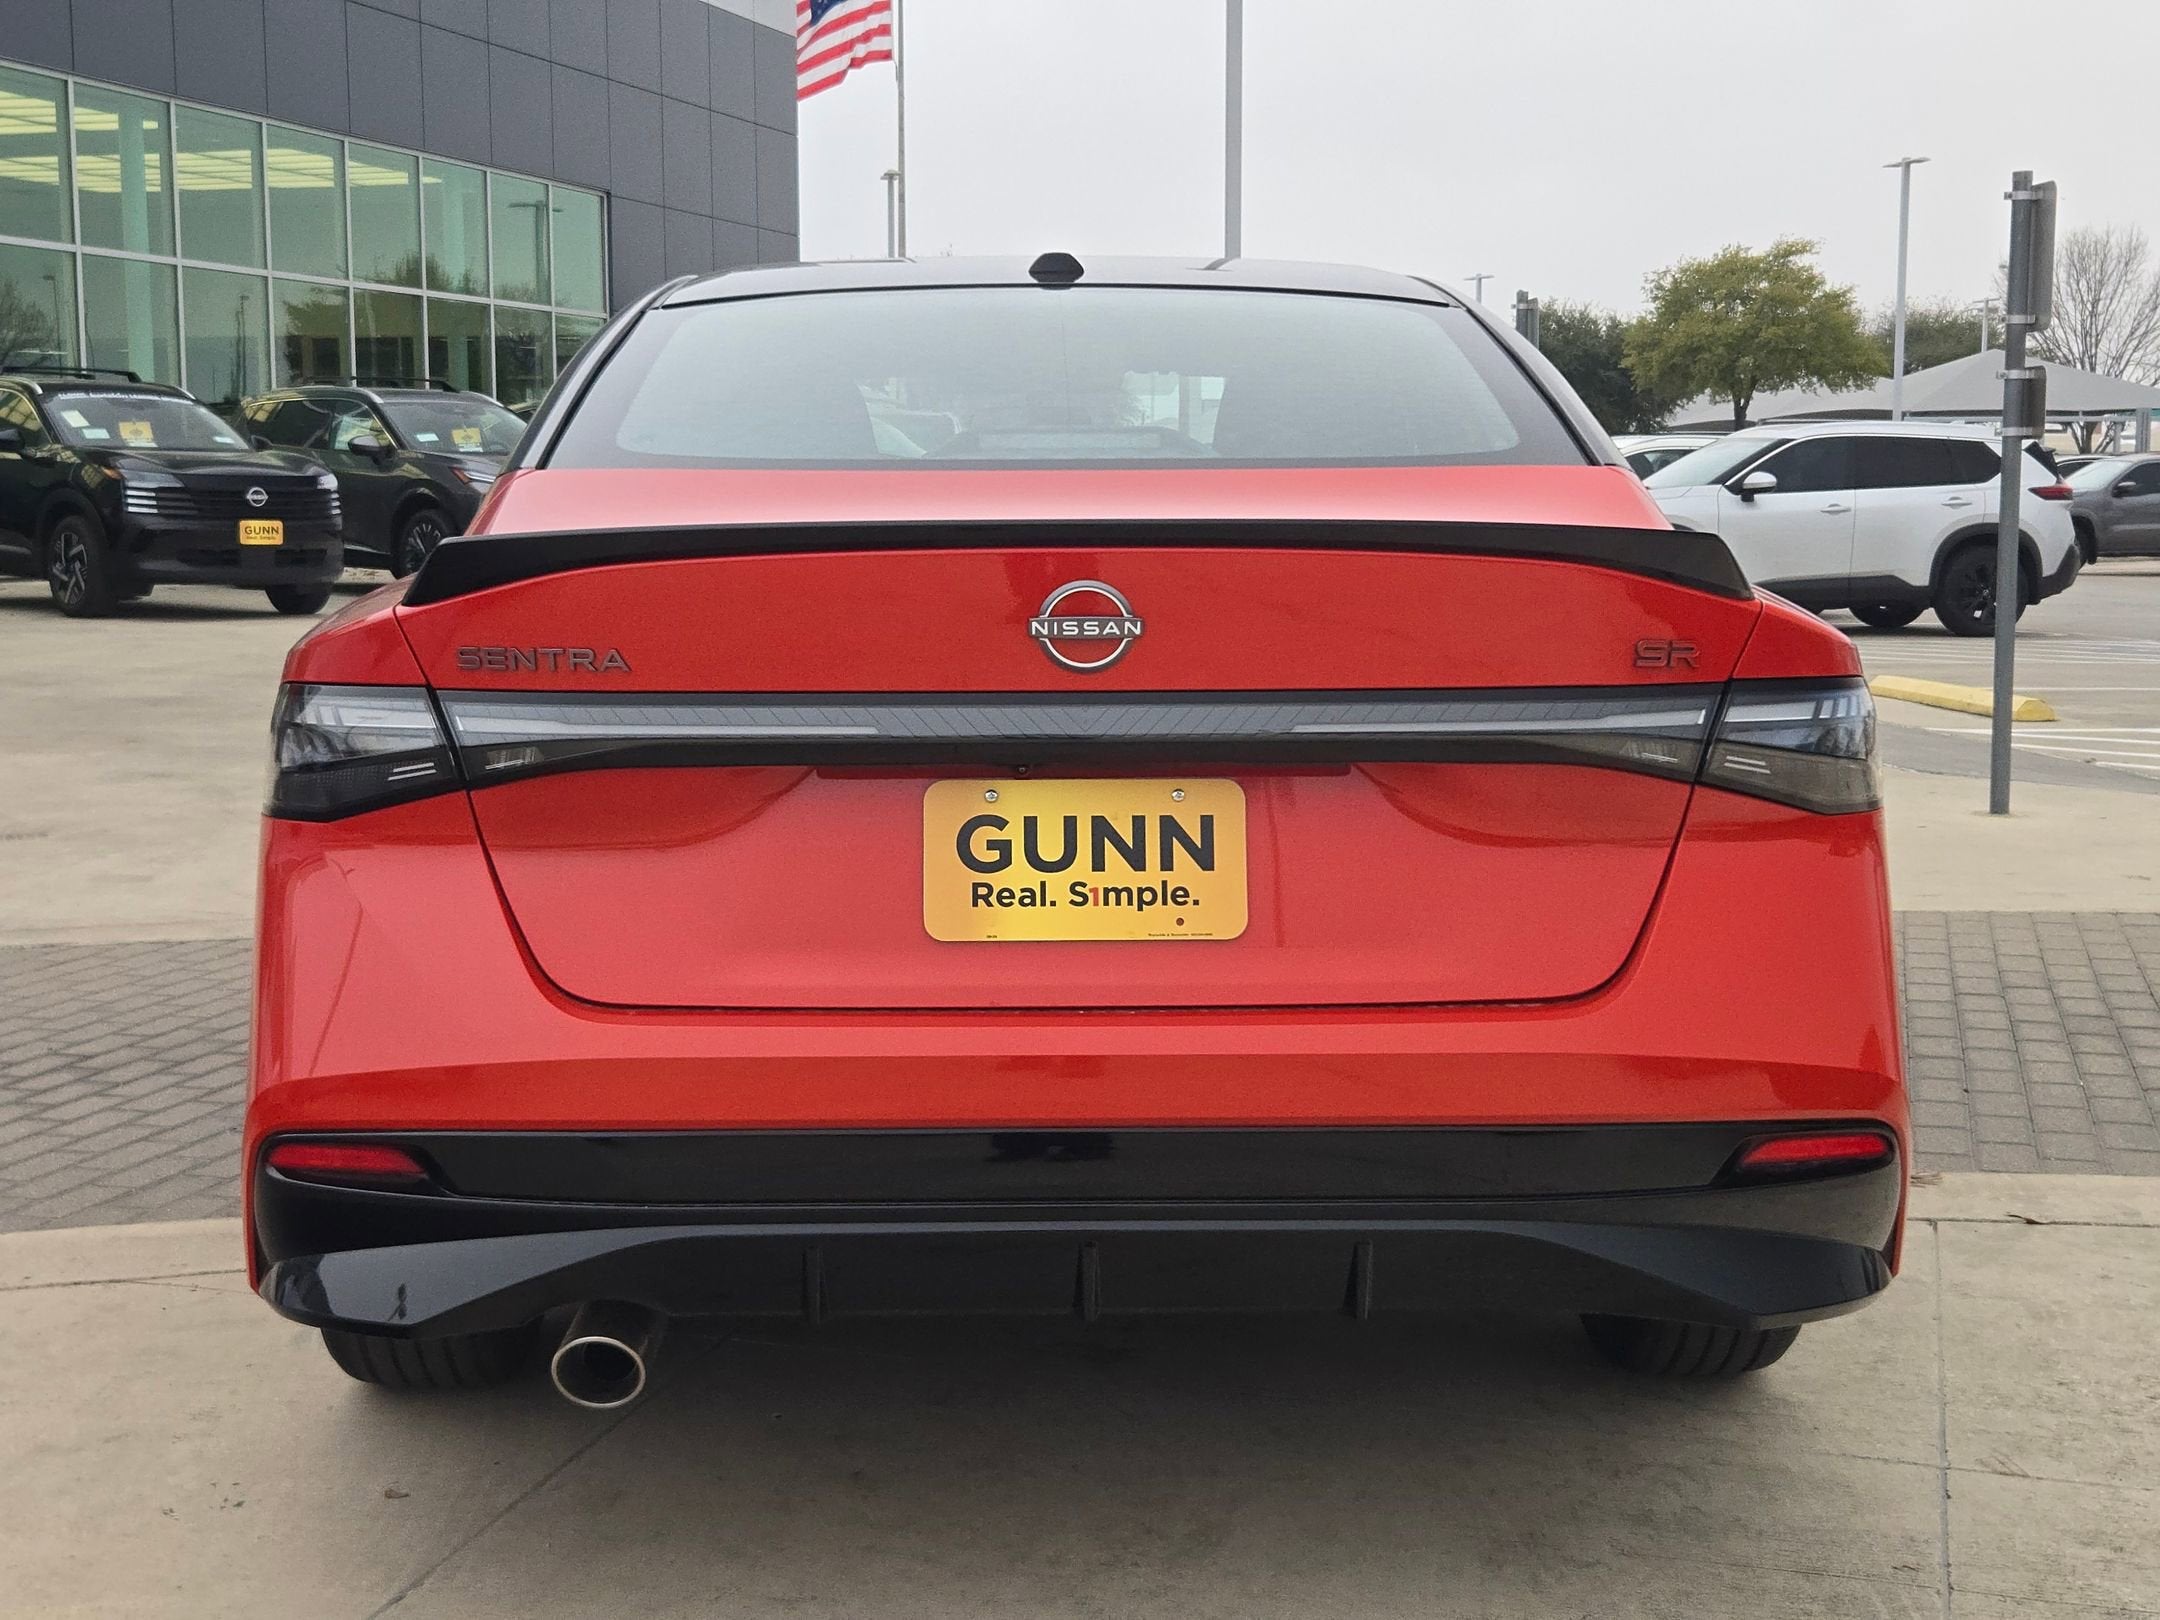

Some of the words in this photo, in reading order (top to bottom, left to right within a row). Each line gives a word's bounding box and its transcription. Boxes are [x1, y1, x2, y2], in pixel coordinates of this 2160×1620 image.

[244, 525, 279, 535] GUNN
[1031, 621, 1141, 635] NISSAN
[456, 646, 632, 673] SENTRA
[1634, 638, 1699, 668] SR
[955, 814, 1215, 874] GUNN
[971, 881, 1057, 908] Real.
